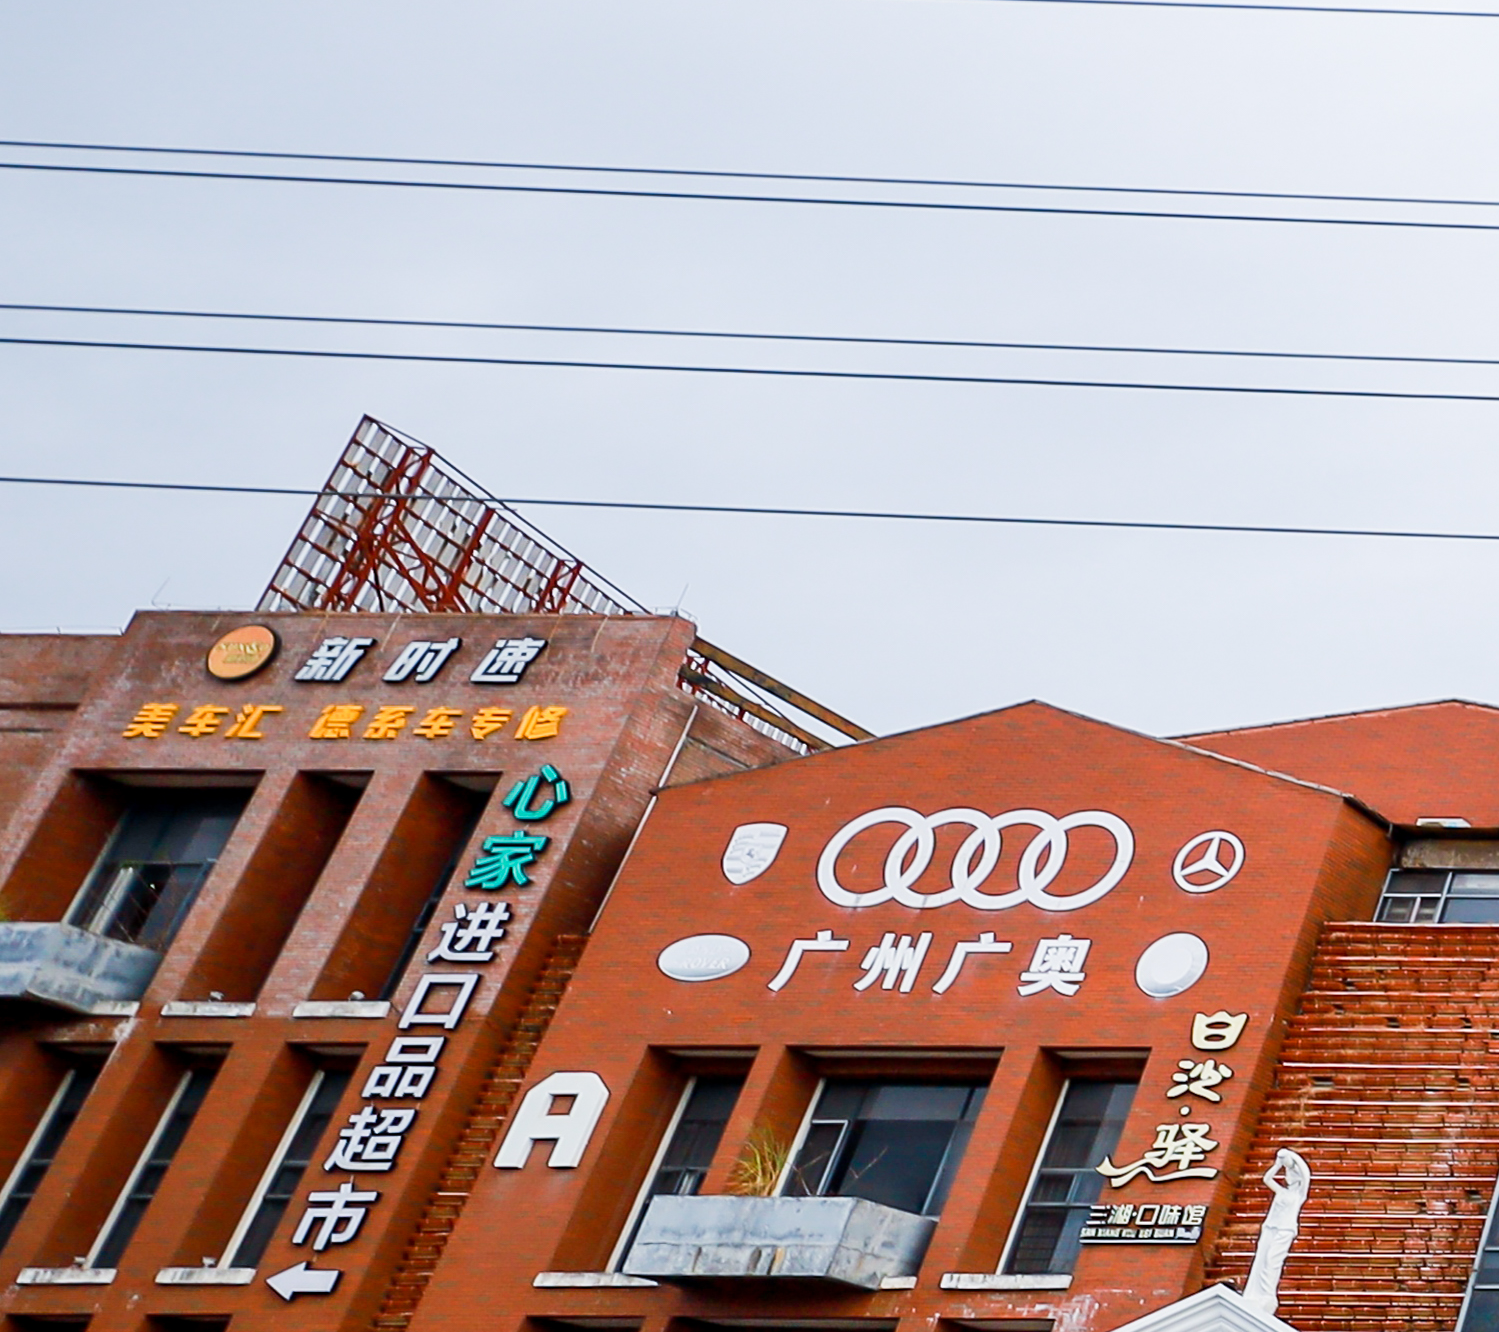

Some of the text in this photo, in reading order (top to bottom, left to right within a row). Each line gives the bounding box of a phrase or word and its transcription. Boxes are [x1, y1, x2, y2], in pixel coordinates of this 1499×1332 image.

[294, 635, 547, 684] 新时速
[123, 702, 569, 742] 美车汇 德系车专修
[767, 930, 1092, 996] 广州广奥
[494, 1071, 610, 1170] A
